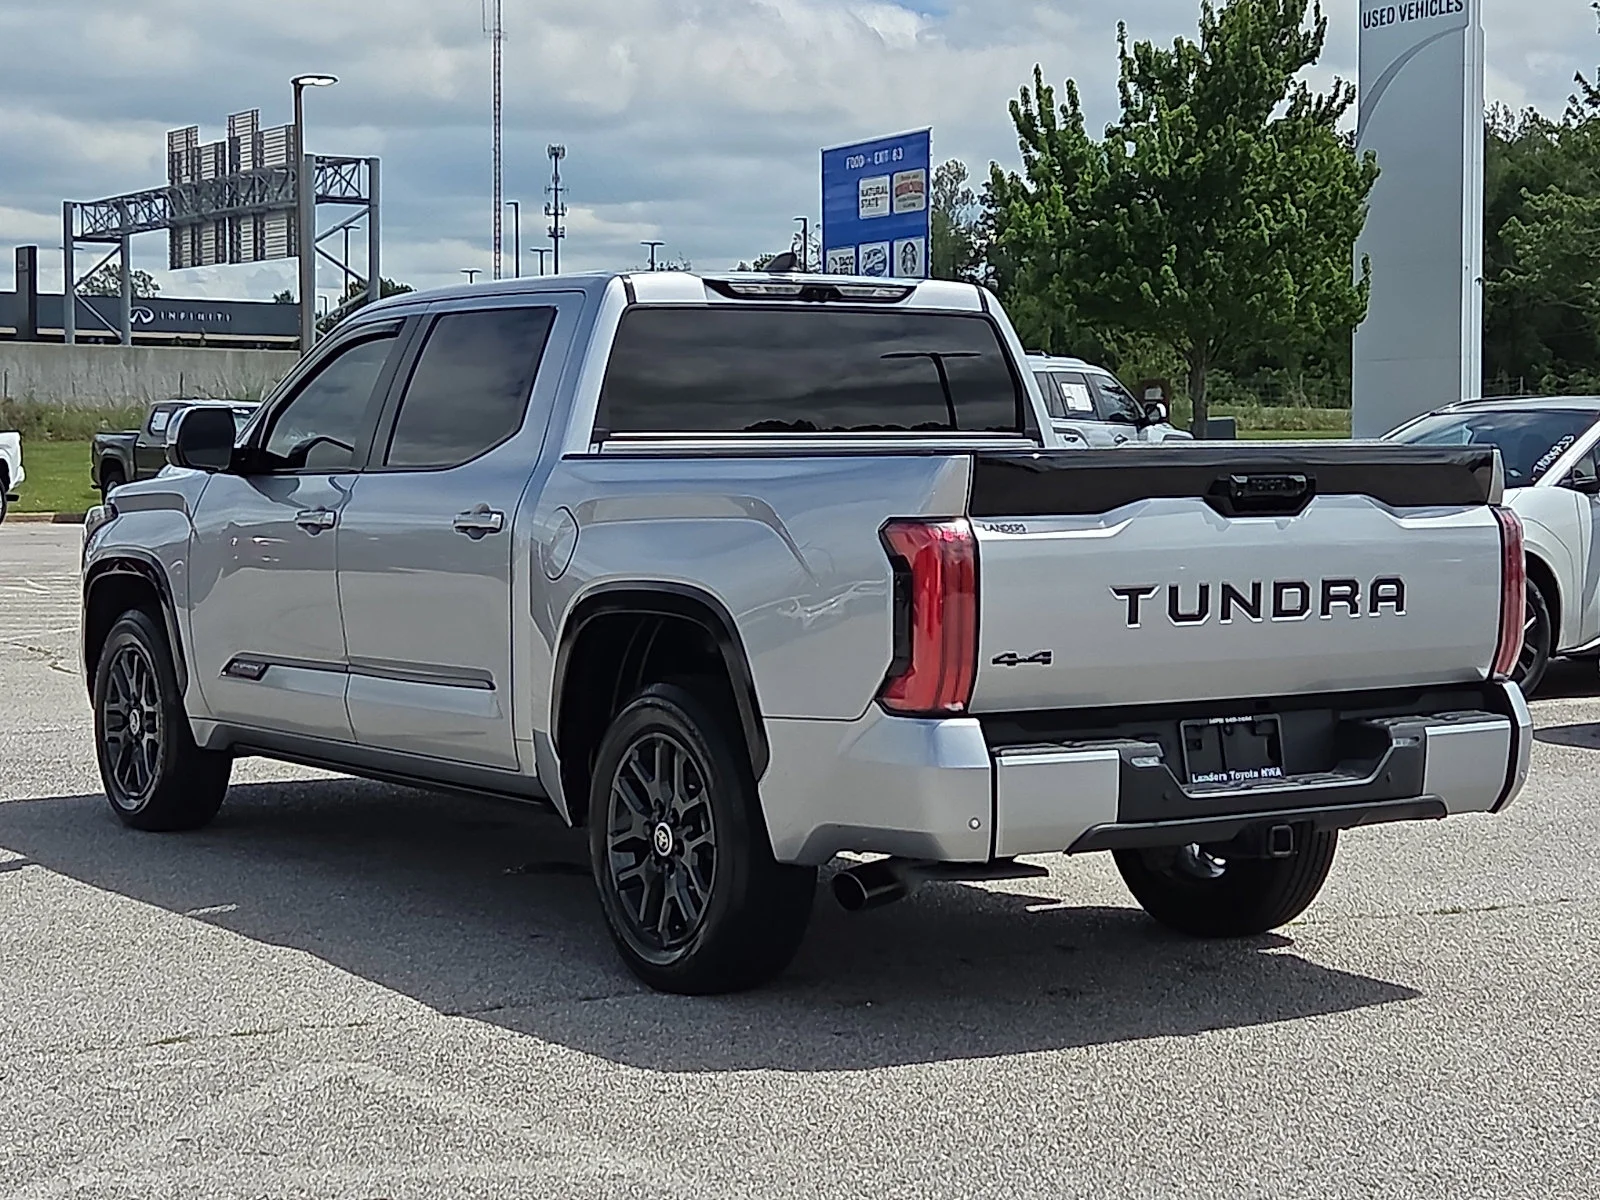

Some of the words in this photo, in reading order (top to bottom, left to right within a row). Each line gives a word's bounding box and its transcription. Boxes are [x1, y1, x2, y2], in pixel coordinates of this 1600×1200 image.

[1363, 6, 1395, 29] USED
[1399, 0, 1463, 22] VEHICLES
[846, 154, 865, 170] FOOD
[874, 149, 889, 165] EXIT
[861, 185, 888, 197] NATURAL
[861, 197, 879, 208] STATE
[160, 311, 230, 322] INFINITI
[1109, 574, 1407, 628] TUNDRA
[1192, 772, 1227, 783] Landers
[1229, 769, 1258, 781] Toyota
